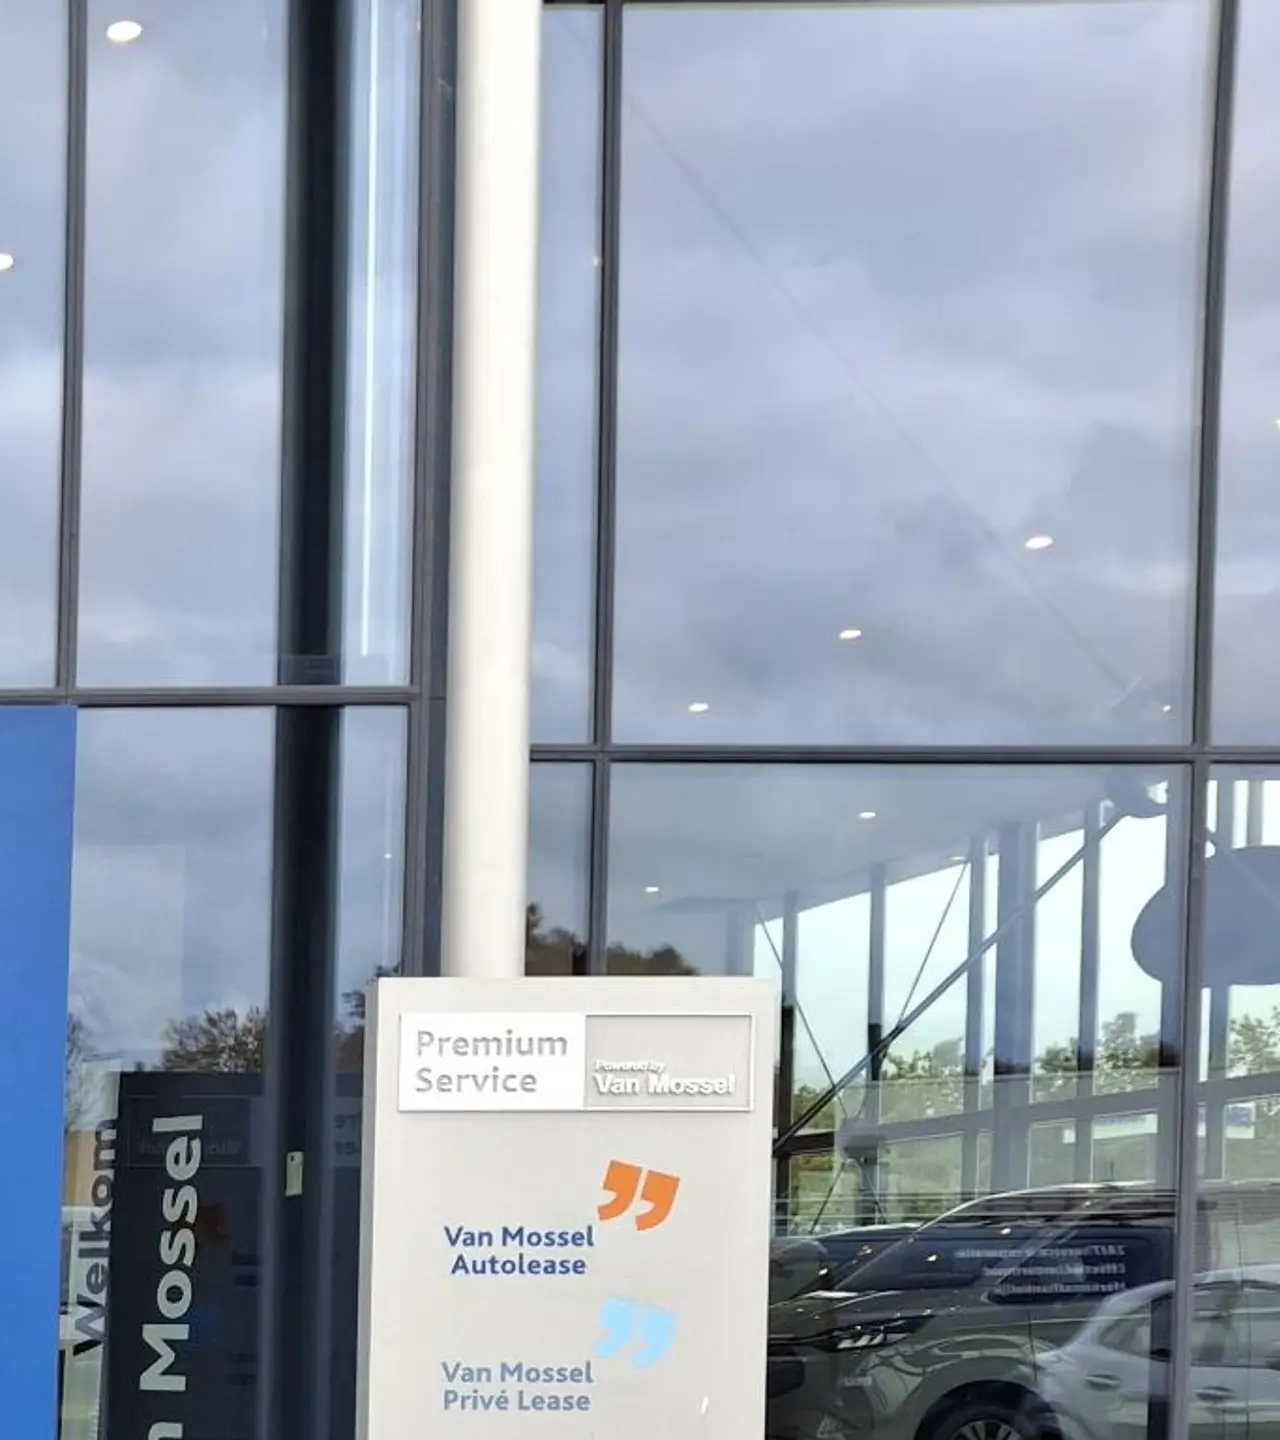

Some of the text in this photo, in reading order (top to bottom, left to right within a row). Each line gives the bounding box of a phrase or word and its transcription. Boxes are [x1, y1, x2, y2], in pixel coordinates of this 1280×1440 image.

[417, 1029, 568, 1057] Premium
[415, 1068, 538, 1094] Service
[594, 1073, 736, 1096] Van Mossel
[72, 1119, 117, 1357] Welkom
[444, 1225, 595, 1247] Van Mossel
[140, 1113, 204, 1392] Mossel
[450, 1254, 587, 1275] Autolease
[441, 1361, 595, 1384] Van Mossel
[443, 1390, 591, 1411] Privé Lease
